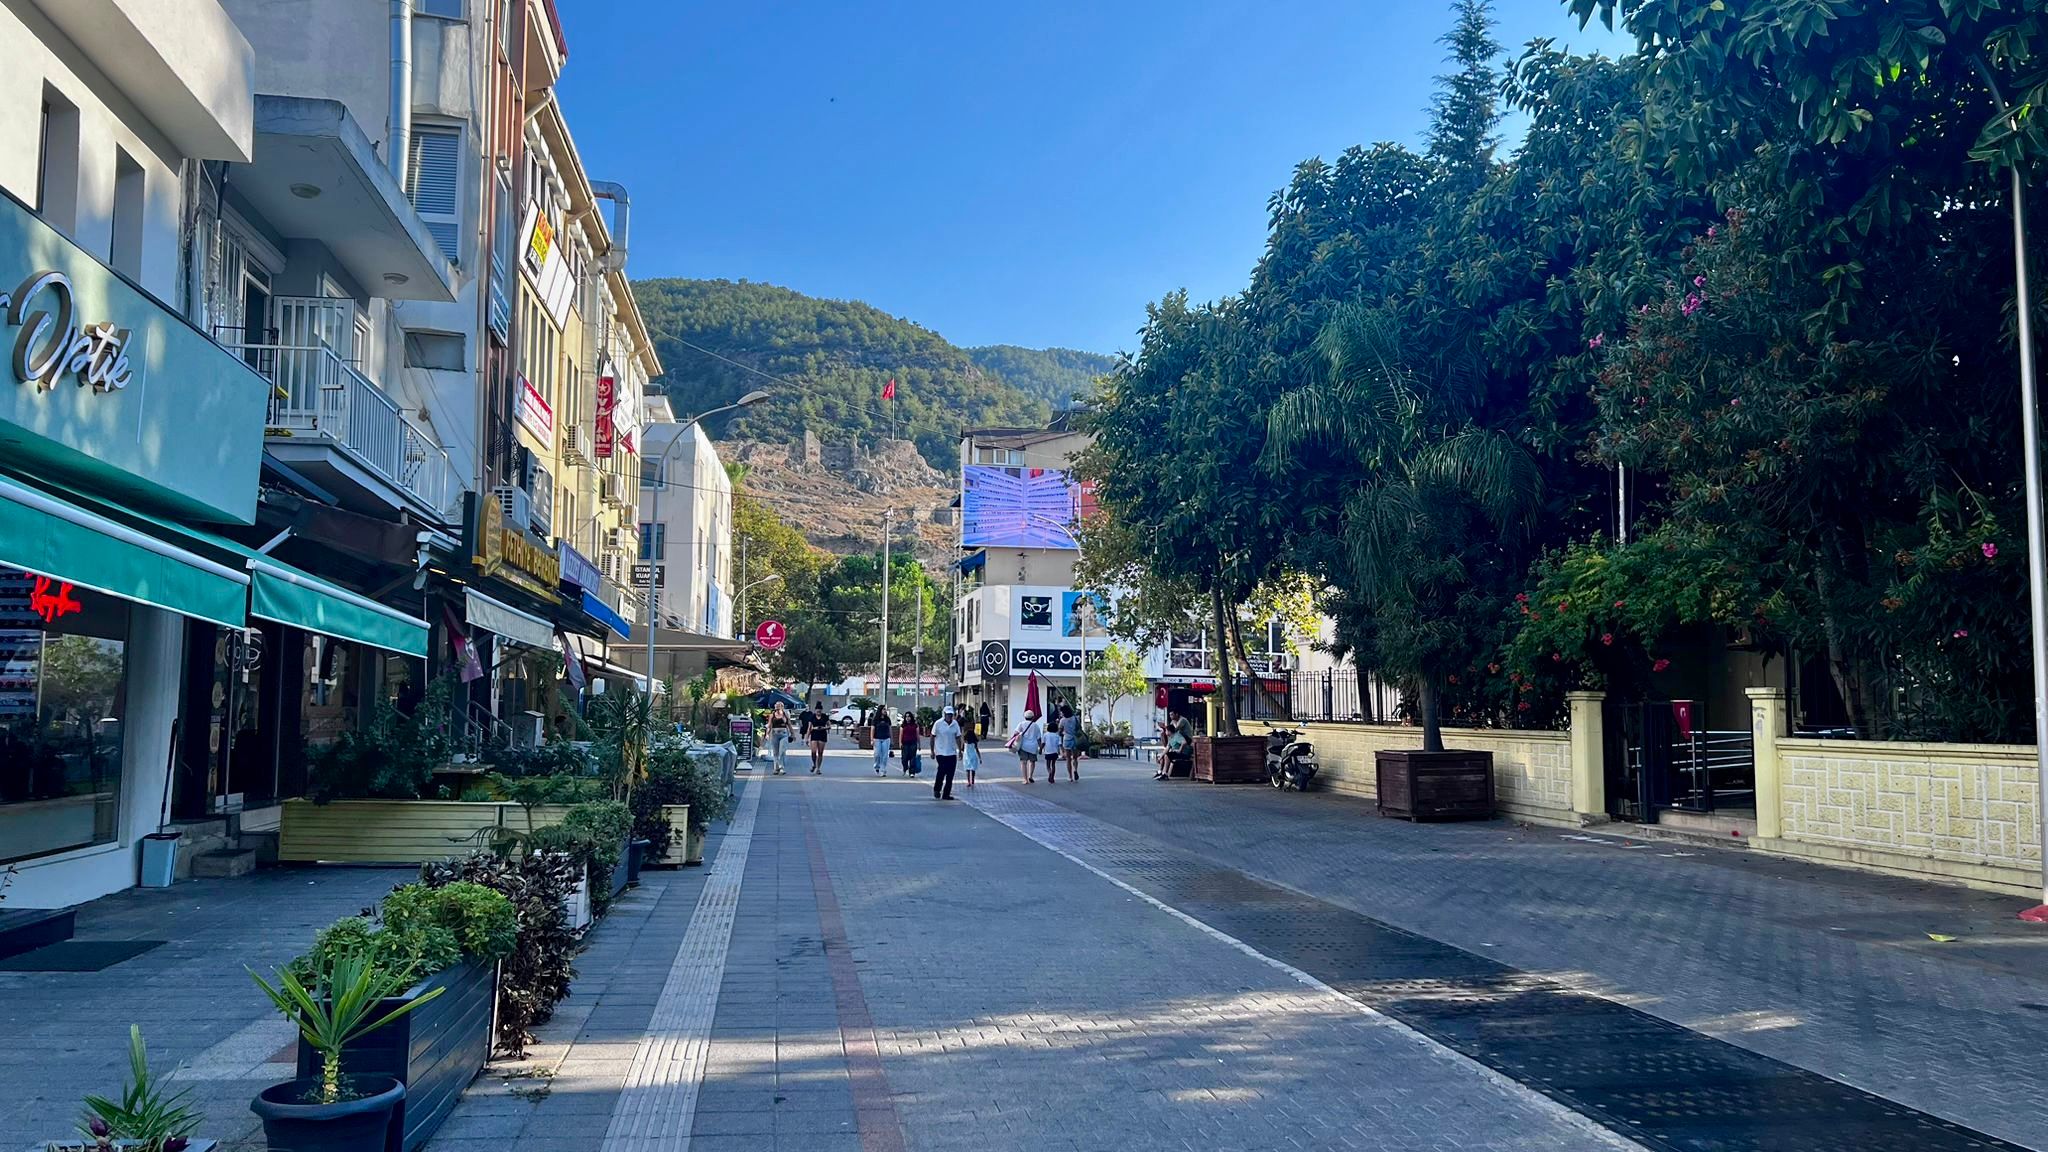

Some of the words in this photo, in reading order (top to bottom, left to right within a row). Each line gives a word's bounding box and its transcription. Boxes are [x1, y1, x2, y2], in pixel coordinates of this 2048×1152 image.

[12, 270, 133, 392] Optik
[1016, 650, 1055, 667] Genç
[1060, 651, 1101, 668] Opik
